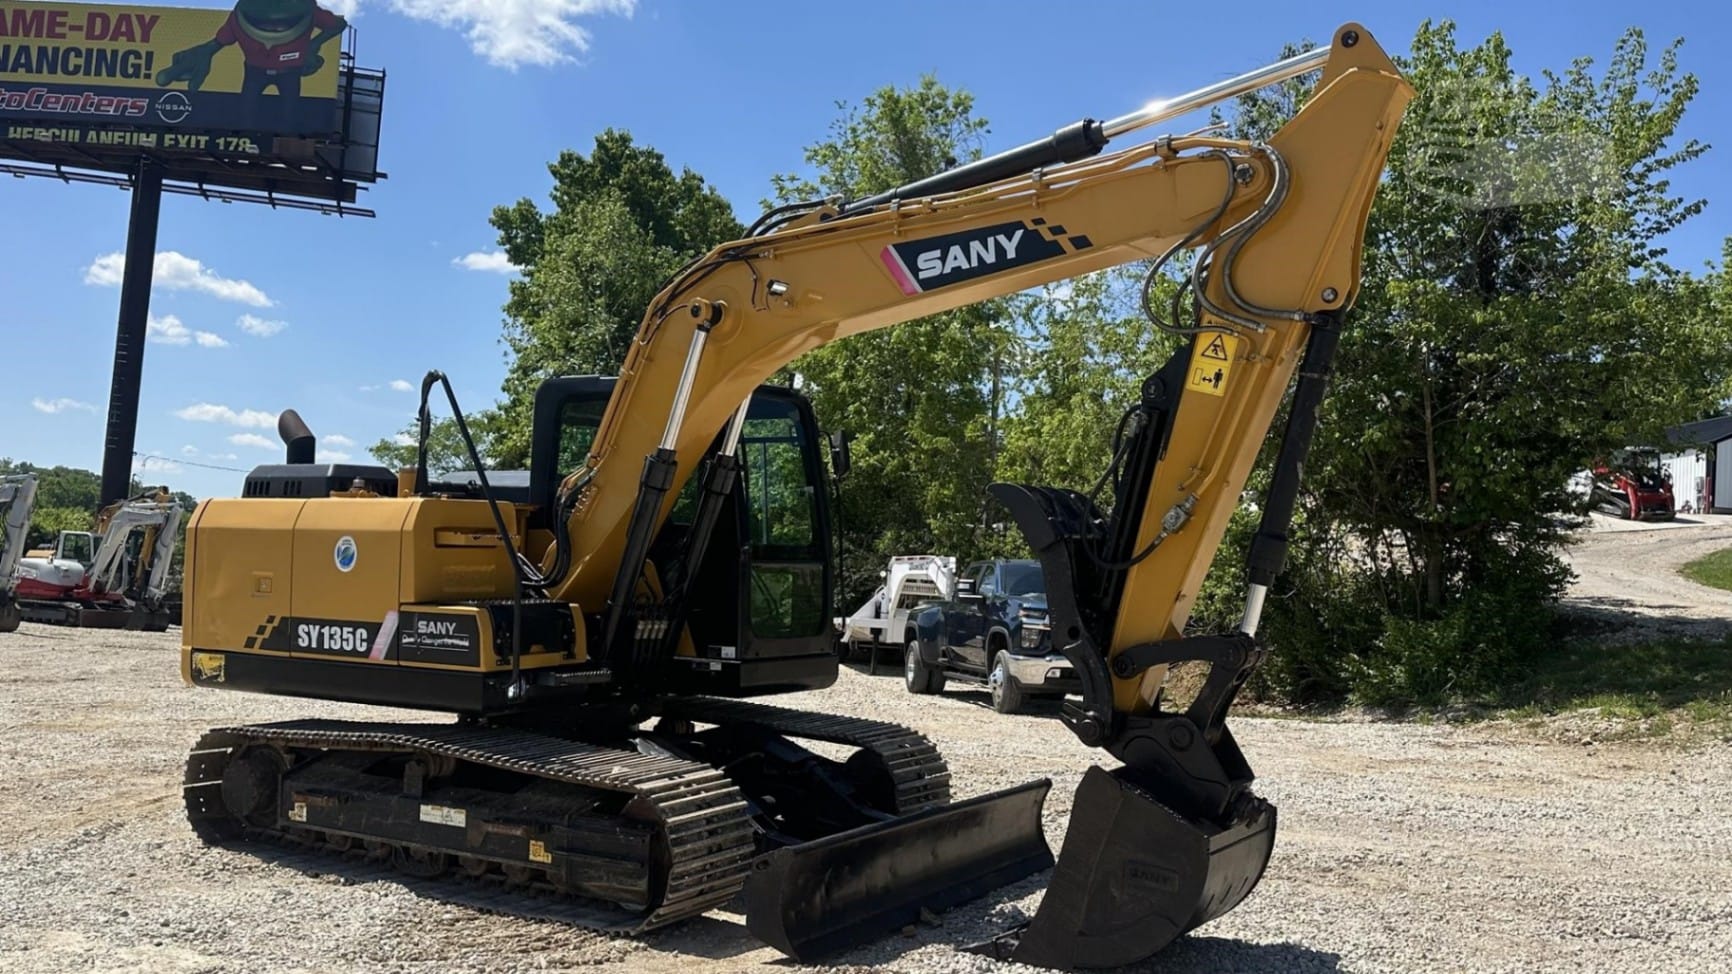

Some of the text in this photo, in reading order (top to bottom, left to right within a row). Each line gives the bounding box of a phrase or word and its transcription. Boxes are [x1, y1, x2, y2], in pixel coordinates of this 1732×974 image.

[155, 103, 192, 111] NISSAN
[917, 229, 1024, 279] SANY
[297, 624, 367, 651] SY135C
[417, 620, 456, 635] SANY
